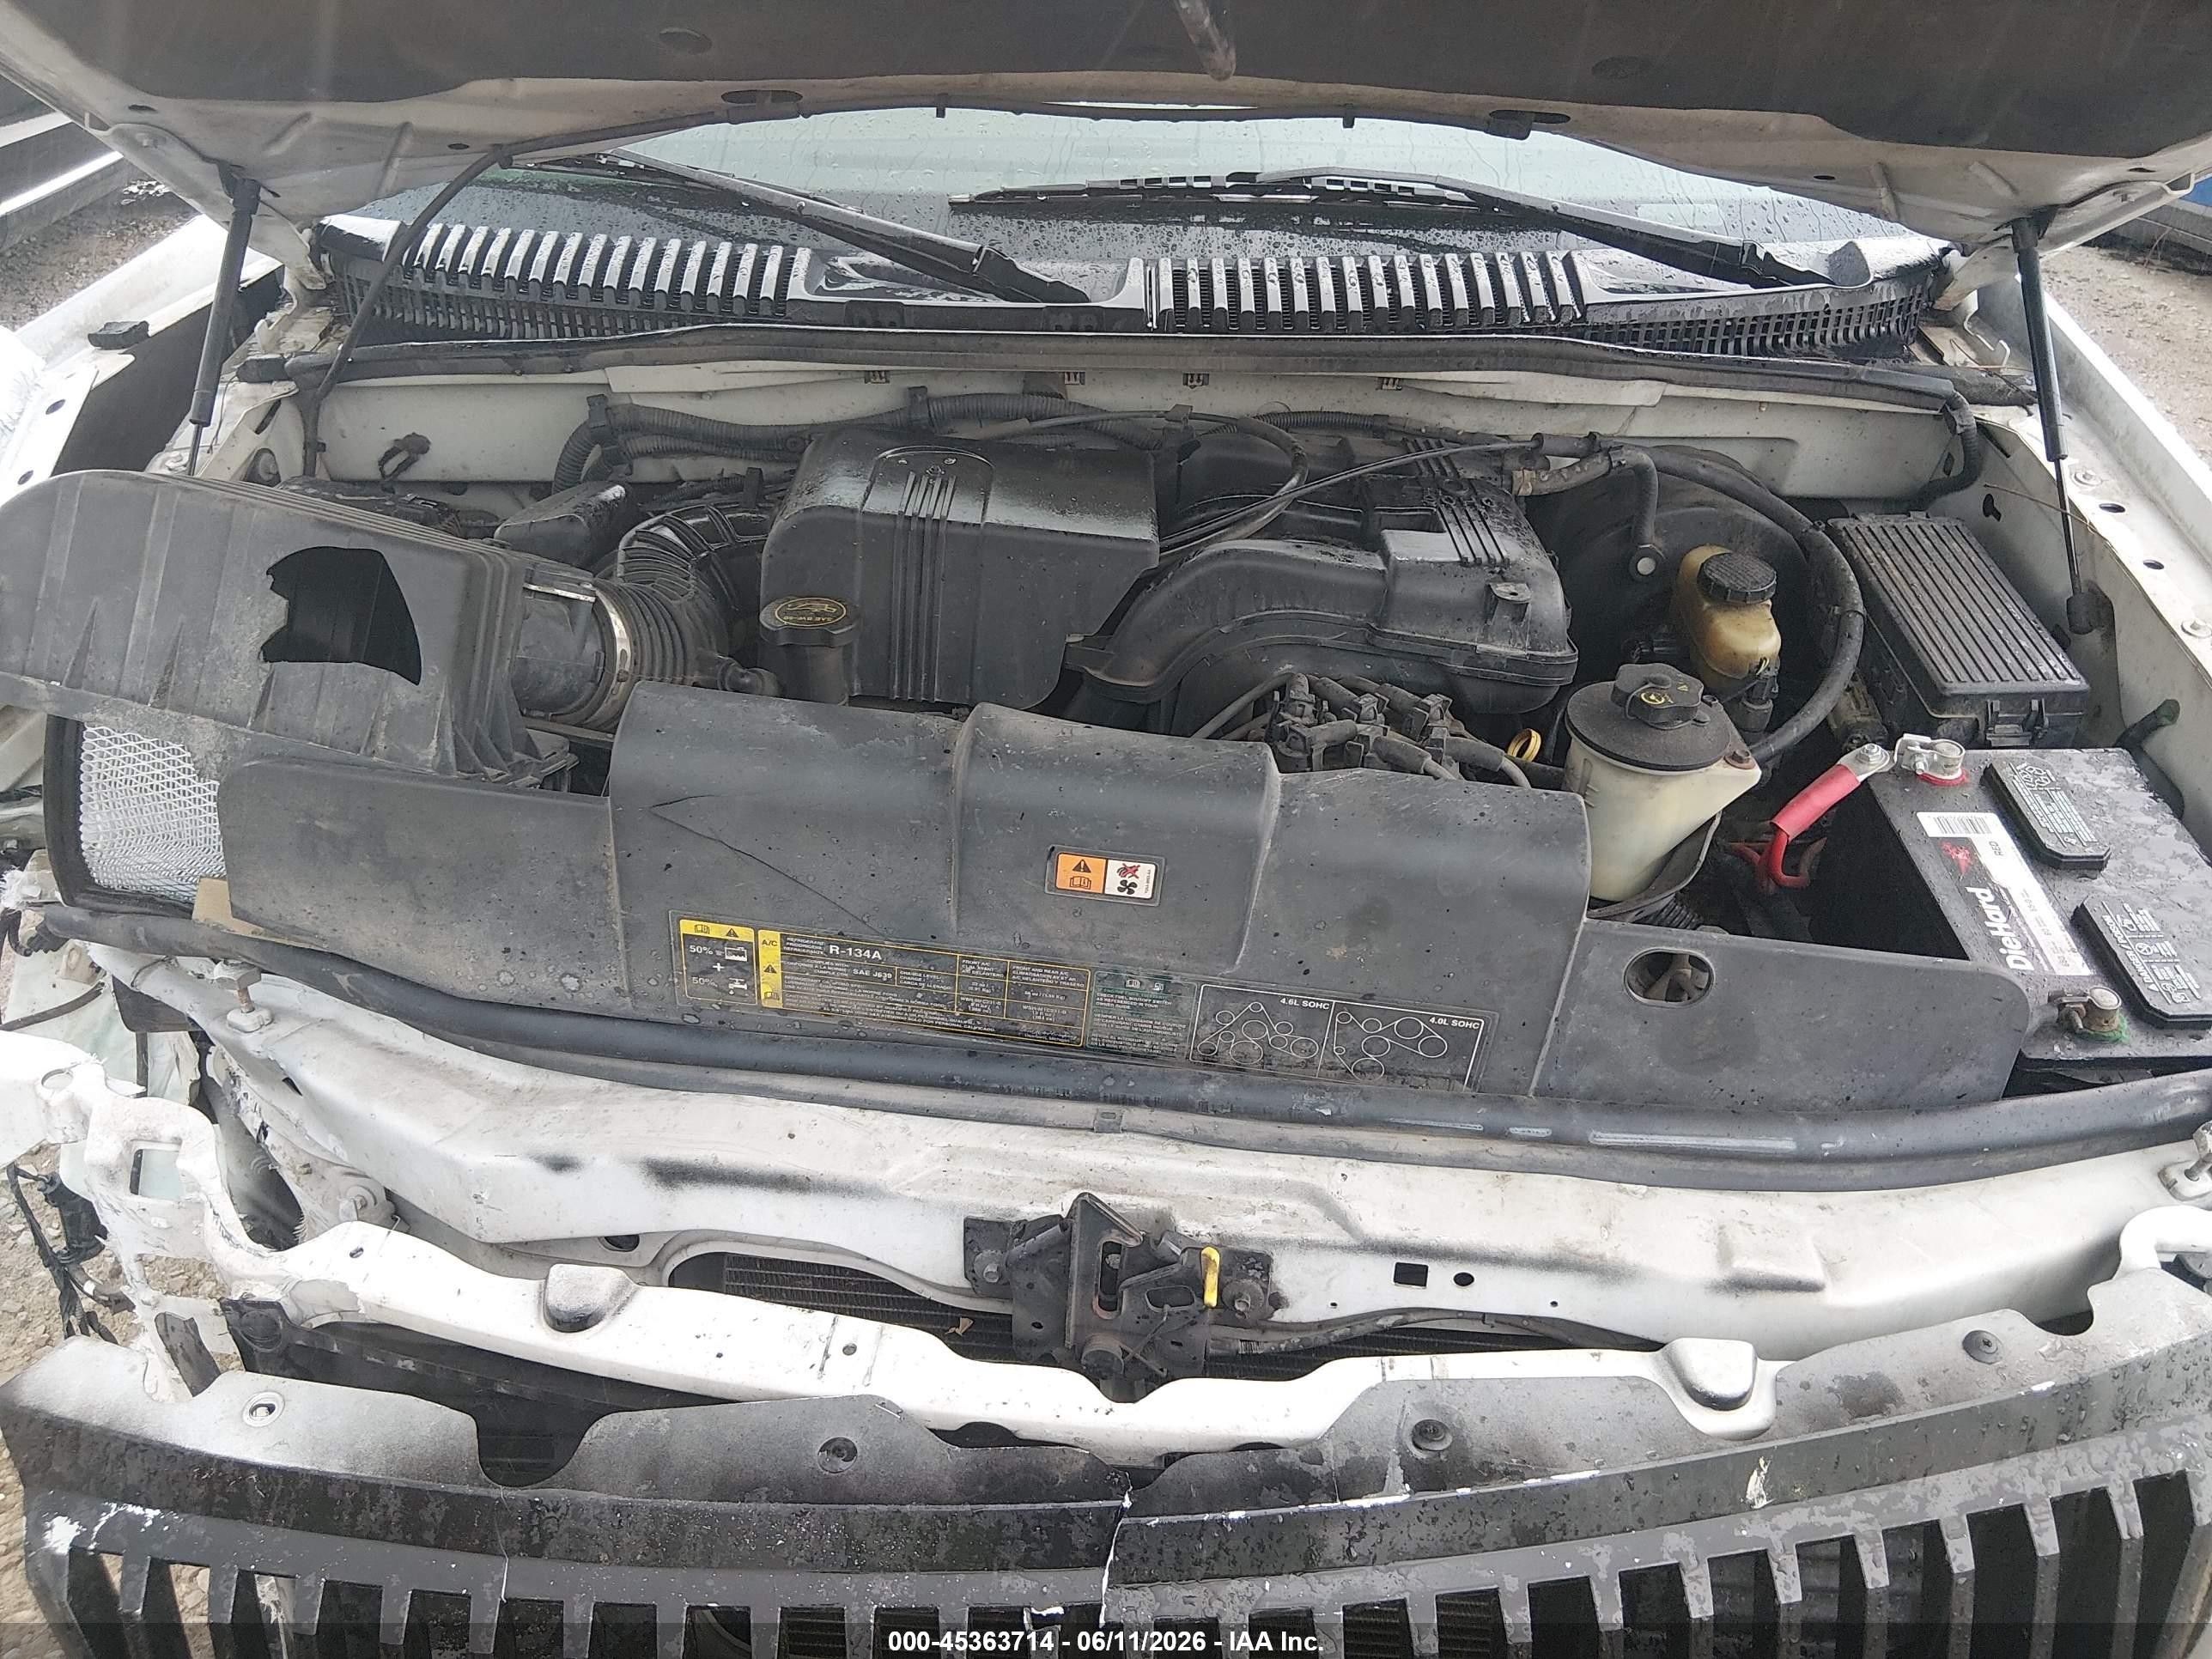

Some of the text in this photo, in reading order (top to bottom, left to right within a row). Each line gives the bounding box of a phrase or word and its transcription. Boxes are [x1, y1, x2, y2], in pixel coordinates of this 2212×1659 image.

[1964, 886, 2035, 971] DieHard
[2102, 915, 2128, 944] POISON
[762, 939, 778, 947] A/C
[689, 945, 714, 955] 50%
[829, 945, 883, 961] R-134A
[2125, 950, 2154, 983] DANGER
[691, 976, 719, 988] 50%
[1279, 997, 1330, 1010] 4.6L SOHC
[1429, 1017, 1480, 1030] 4.0L SOHC
